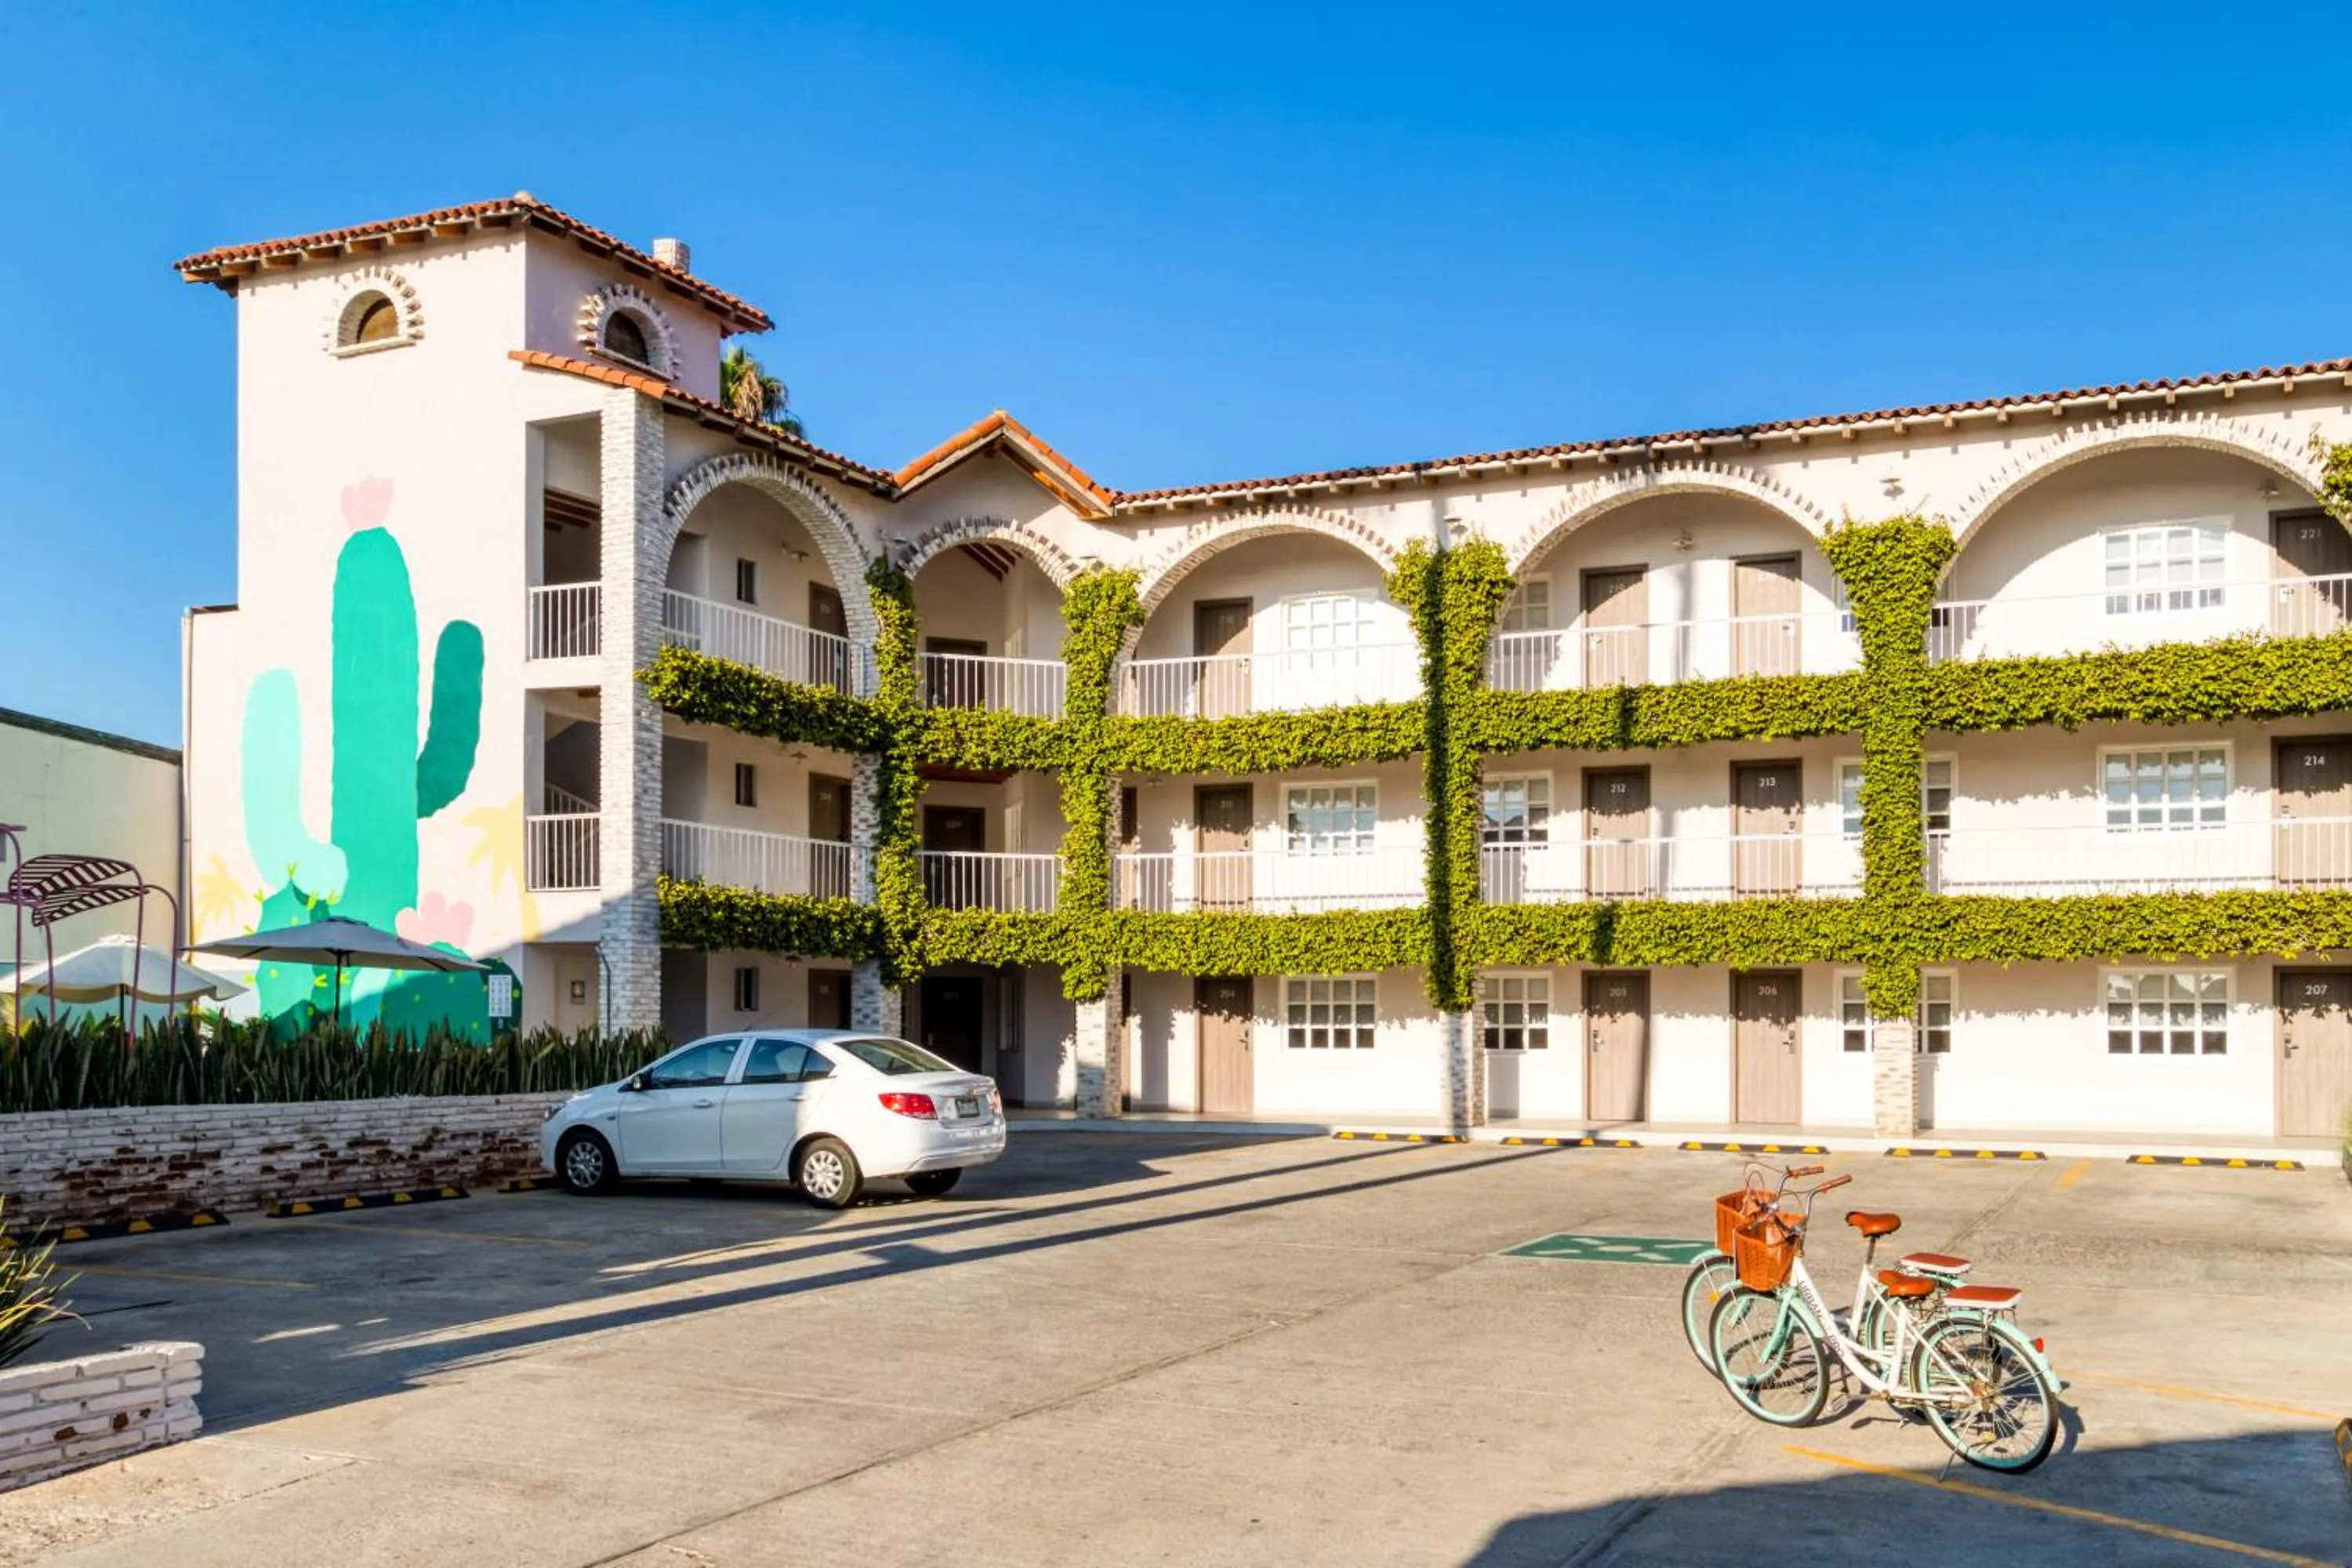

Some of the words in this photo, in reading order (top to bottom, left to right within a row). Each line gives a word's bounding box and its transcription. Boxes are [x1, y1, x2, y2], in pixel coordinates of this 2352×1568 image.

[2304, 755, 2325, 766] 214
[1759, 777, 1776, 787] 213
[1610, 783, 1627, 793] 212
[2305, 984, 2327, 995] 207
